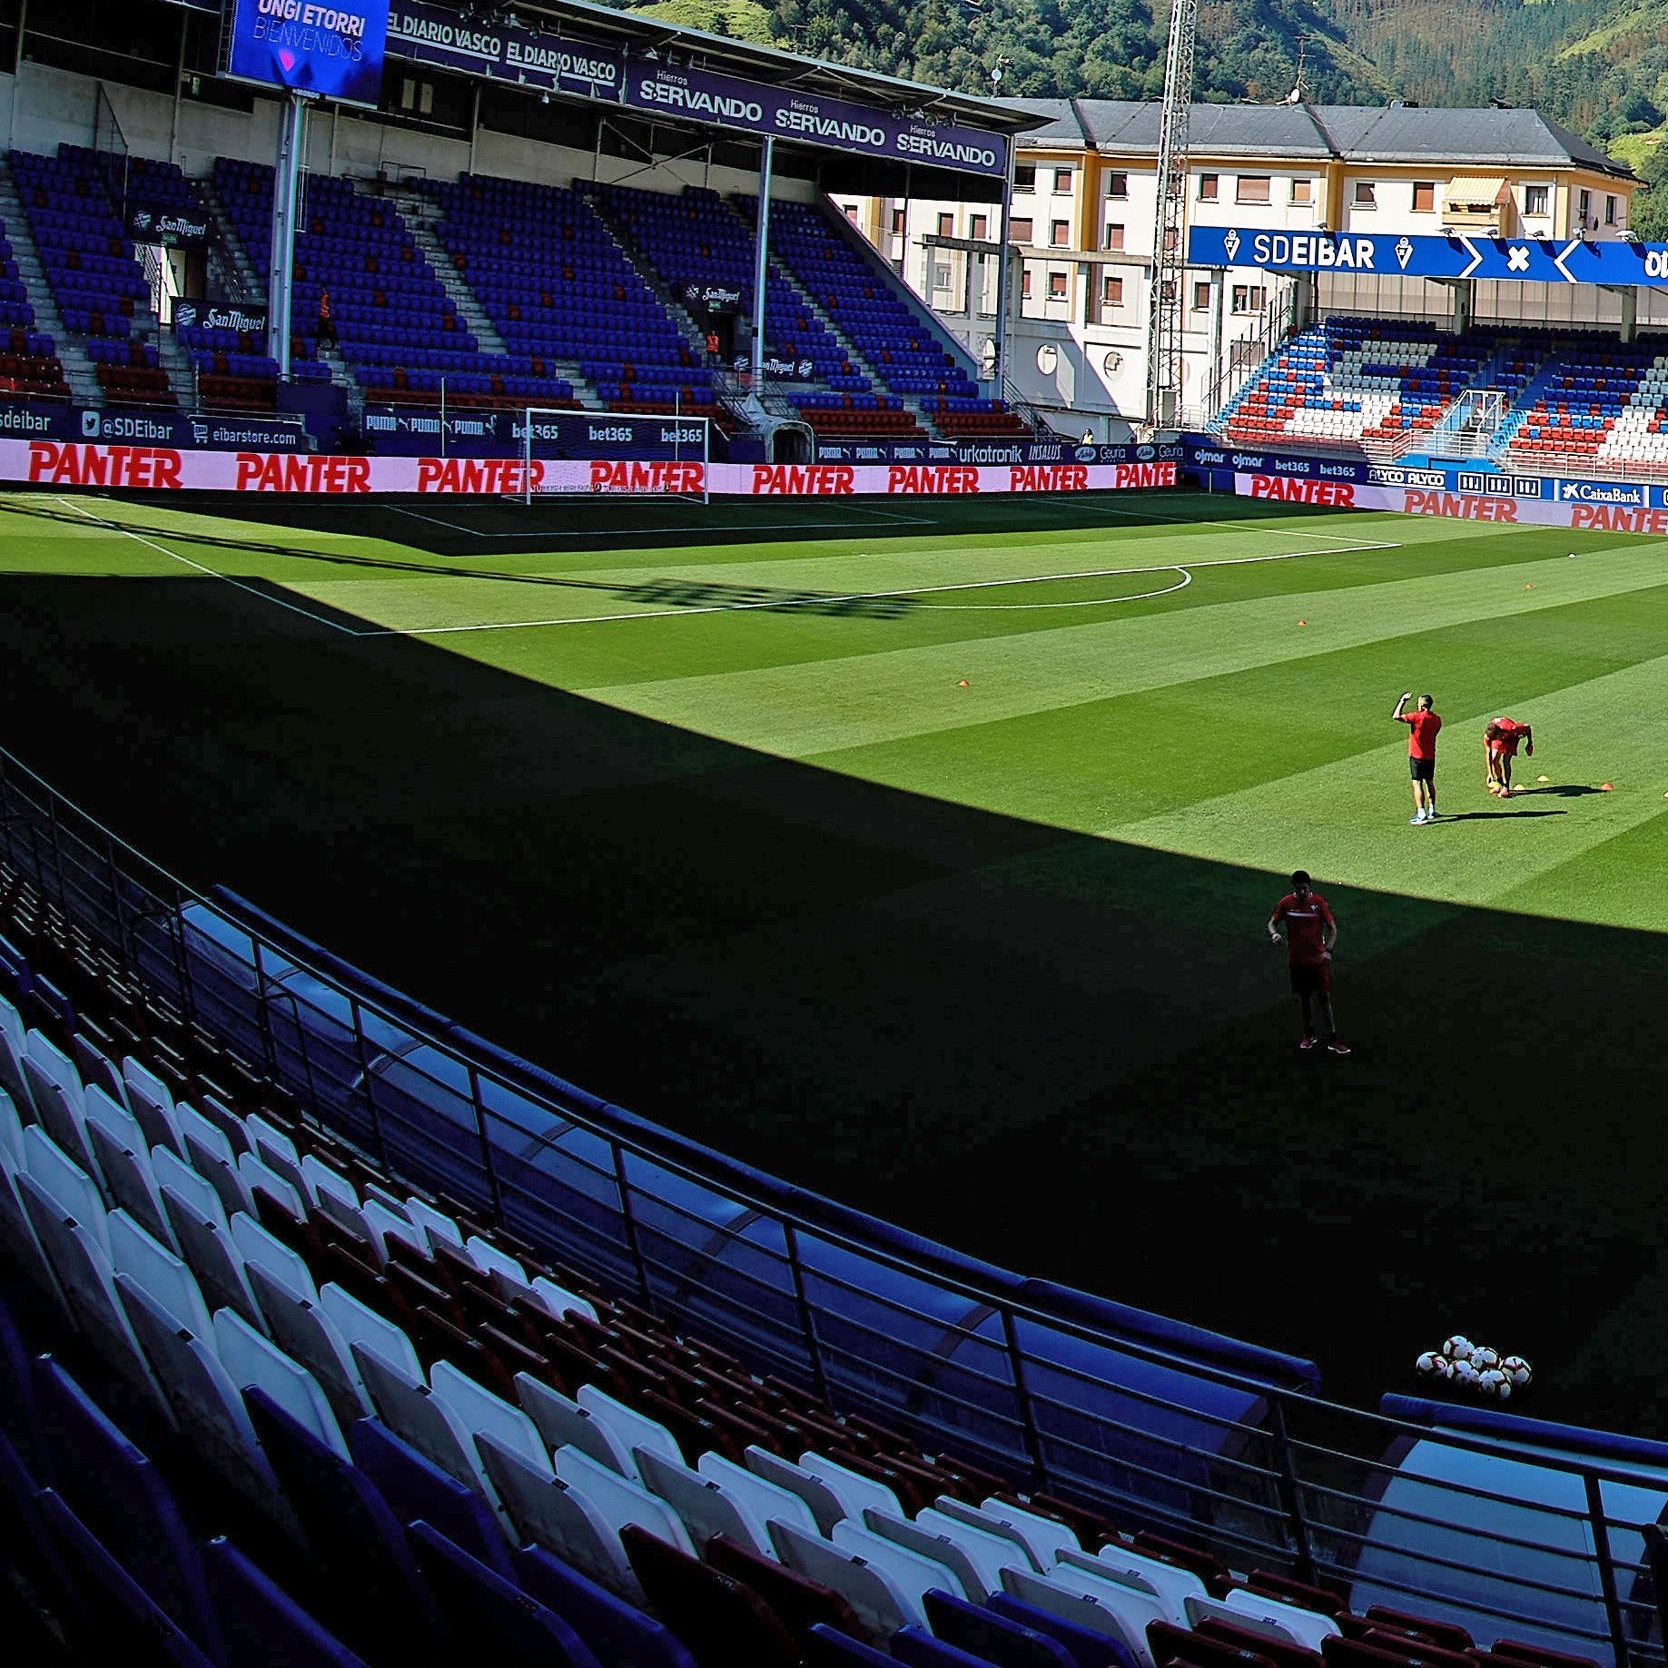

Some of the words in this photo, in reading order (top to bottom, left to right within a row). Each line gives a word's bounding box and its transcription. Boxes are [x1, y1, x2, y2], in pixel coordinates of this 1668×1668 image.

[302, 5, 366, 37] ETORRI
[402, 17, 453, 44] DIARIO
[454, 28, 500, 56] VASCO
[253, 16, 363, 62] BIENVENIDOS
[506, 41, 522, 61] EL
[523, 46, 571, 71] DIARIO
[572, 55, 616, 81] VASCO
[656, 69, 688, 85] Hierros
[640, 81, 763, 122] SERVANDO
[791, 99, 819, 114] Hierros
[775, 108, 885, 146] SERVANDO
[896, 133, 996, 167] SERVANDO
[102, 418, 173, 440] @SDEibar
[213, 428, 296, 446] eibarstore.com
[589, 426, 633, 442] bet365
[661, 428, 703, 442] bet365
[28, 441, 183, 489] PANTER
[959, 445, 1023, 463] urkotronik
[1275, 460, 1310, 472] bet365
[1320, 464, 1356, 477] bet365
[236, 453, 372, 492] PANTER
[417, 458, 545, 493] PANTER
[590, 460, 705, 493] PANTER
[752, 464, 855, 495] PANTER
[888, 466, 980, 494] PANTER
[1009, 465, 1089, 491] PANTER
[1115, 462, 1177, 489] PANTE
[1408, 473, 1445, 486] ALYCO
[1251, 474, 1356, 508] PANTER
[1404, 489, 1518, 523] PANTER
[1580, 484, 1641, 504] CaixaBank
